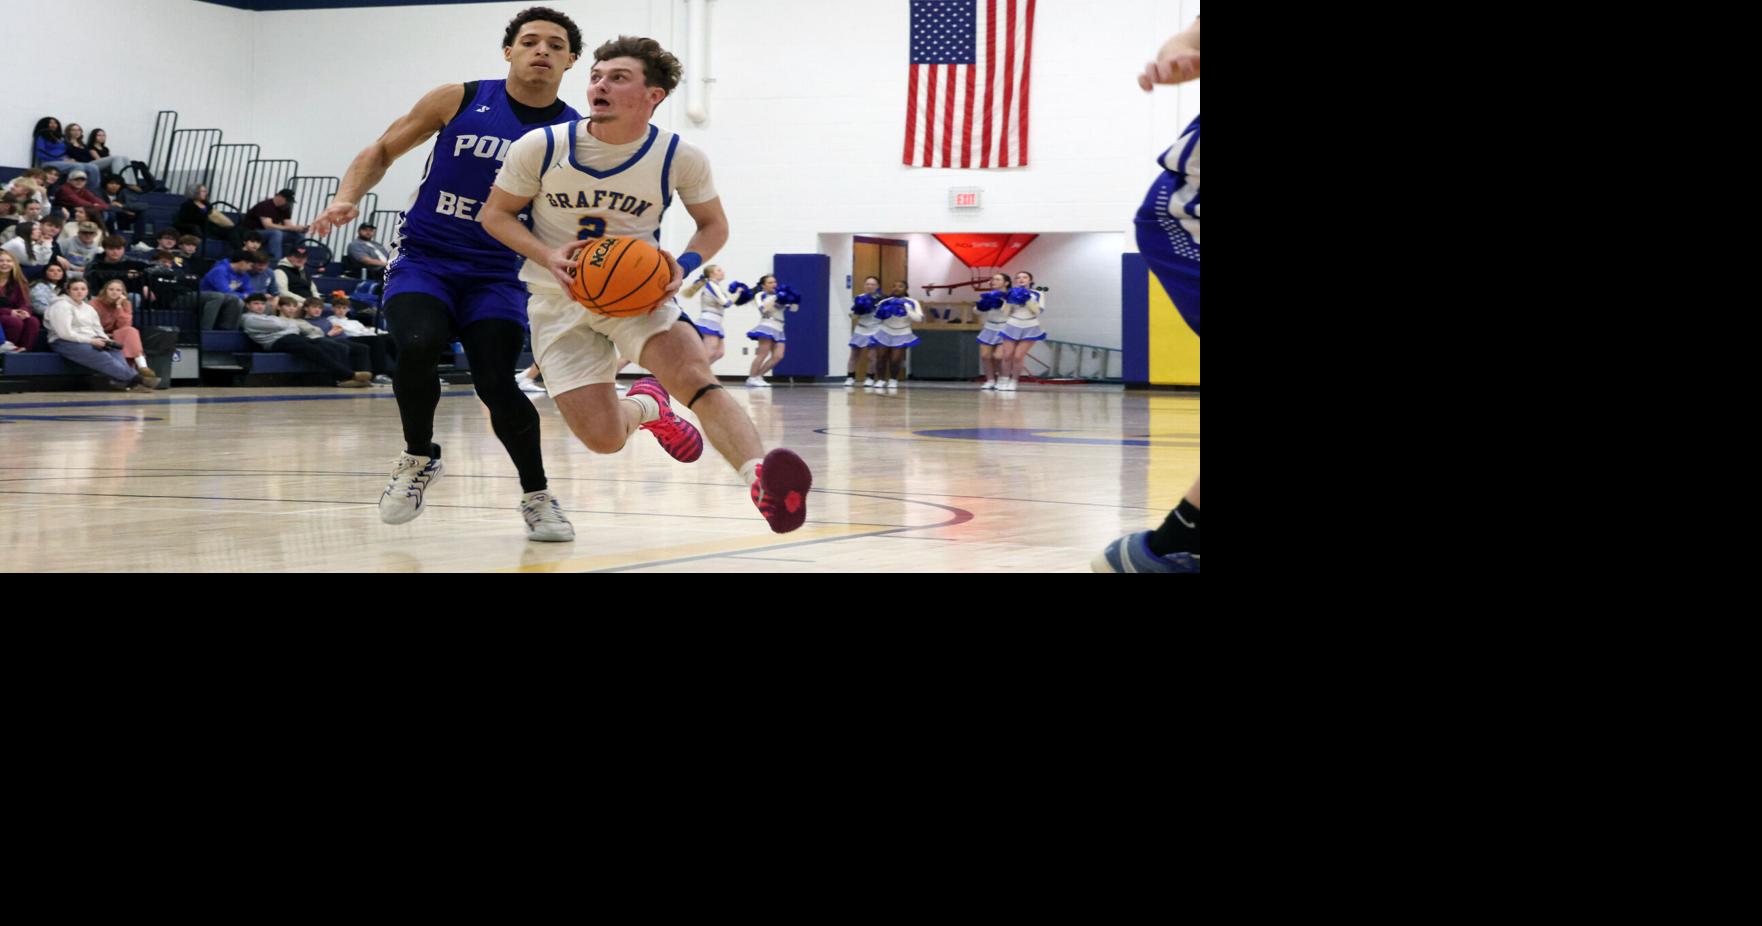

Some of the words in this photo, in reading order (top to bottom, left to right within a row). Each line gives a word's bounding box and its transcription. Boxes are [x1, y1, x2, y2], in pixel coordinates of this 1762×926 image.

[545, 190, 653, 217] GRAFTON
[956, 193, 976, 206] EXIT
[577, 215, 607, 240] 2
